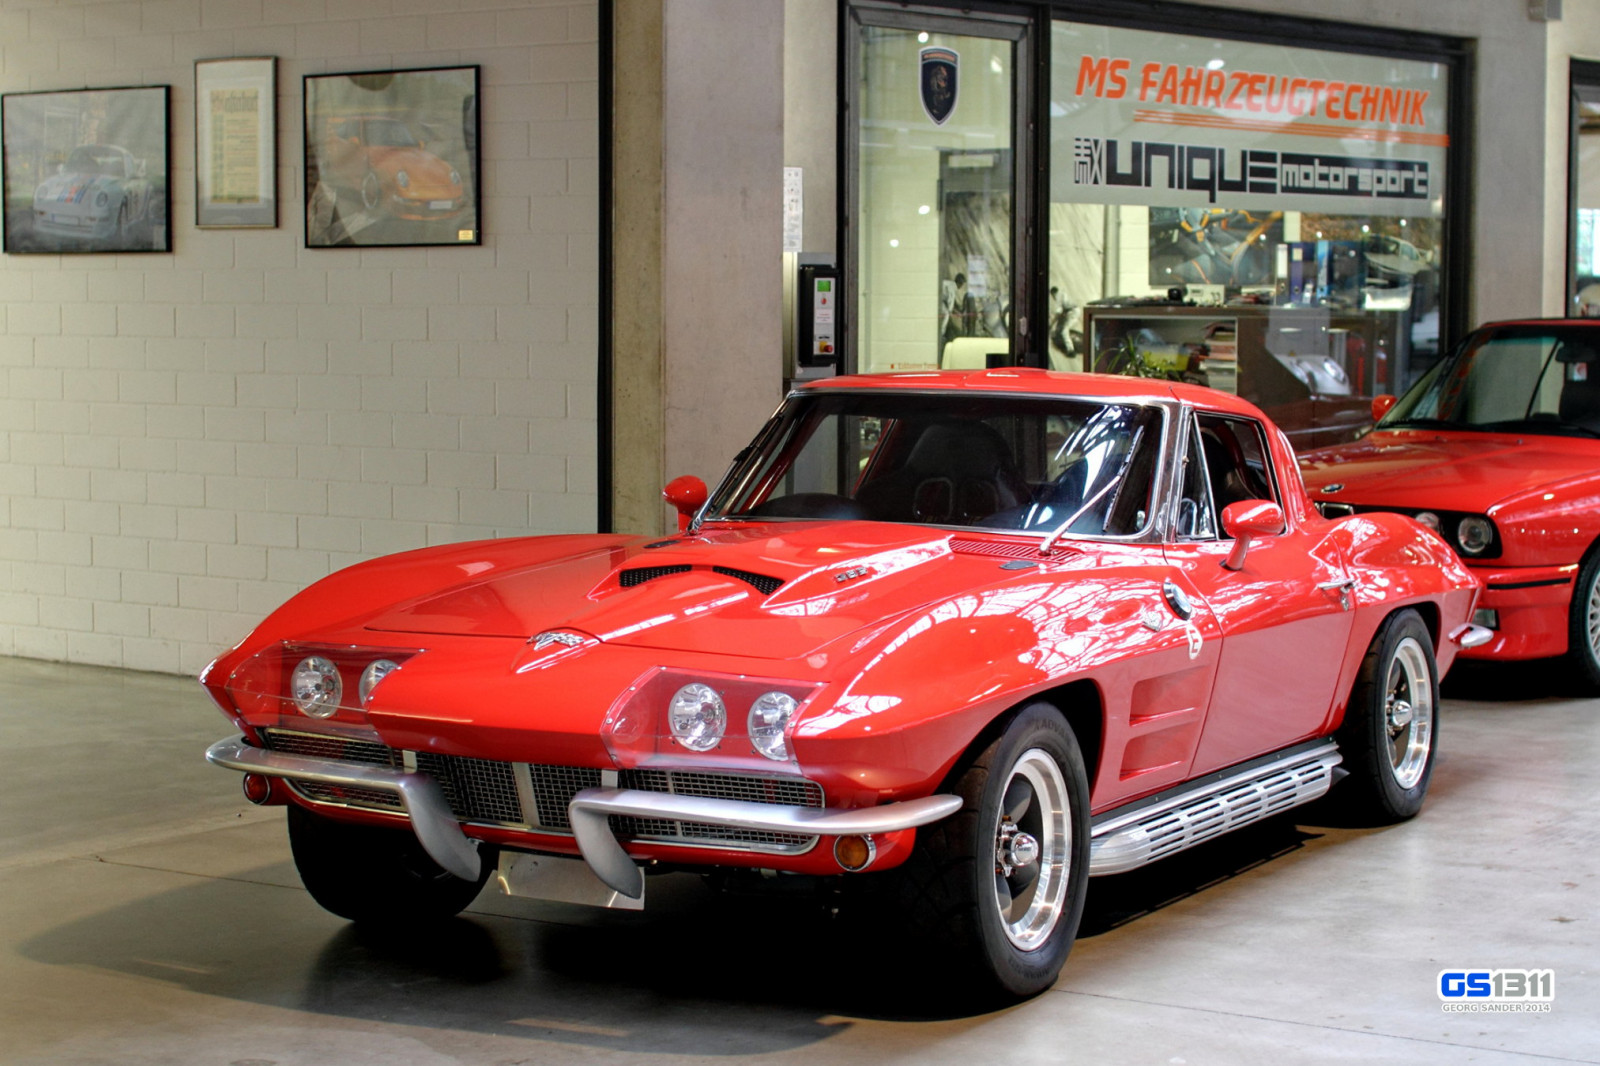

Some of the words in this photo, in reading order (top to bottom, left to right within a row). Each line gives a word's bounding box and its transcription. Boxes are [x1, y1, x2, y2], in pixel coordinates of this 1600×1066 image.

[1075, 55, 1131, 99] MS
[1138, 62, 1430, 126] FAHRZEUGTECHNIK
[1282, 155, 1428, 198] motorsport
